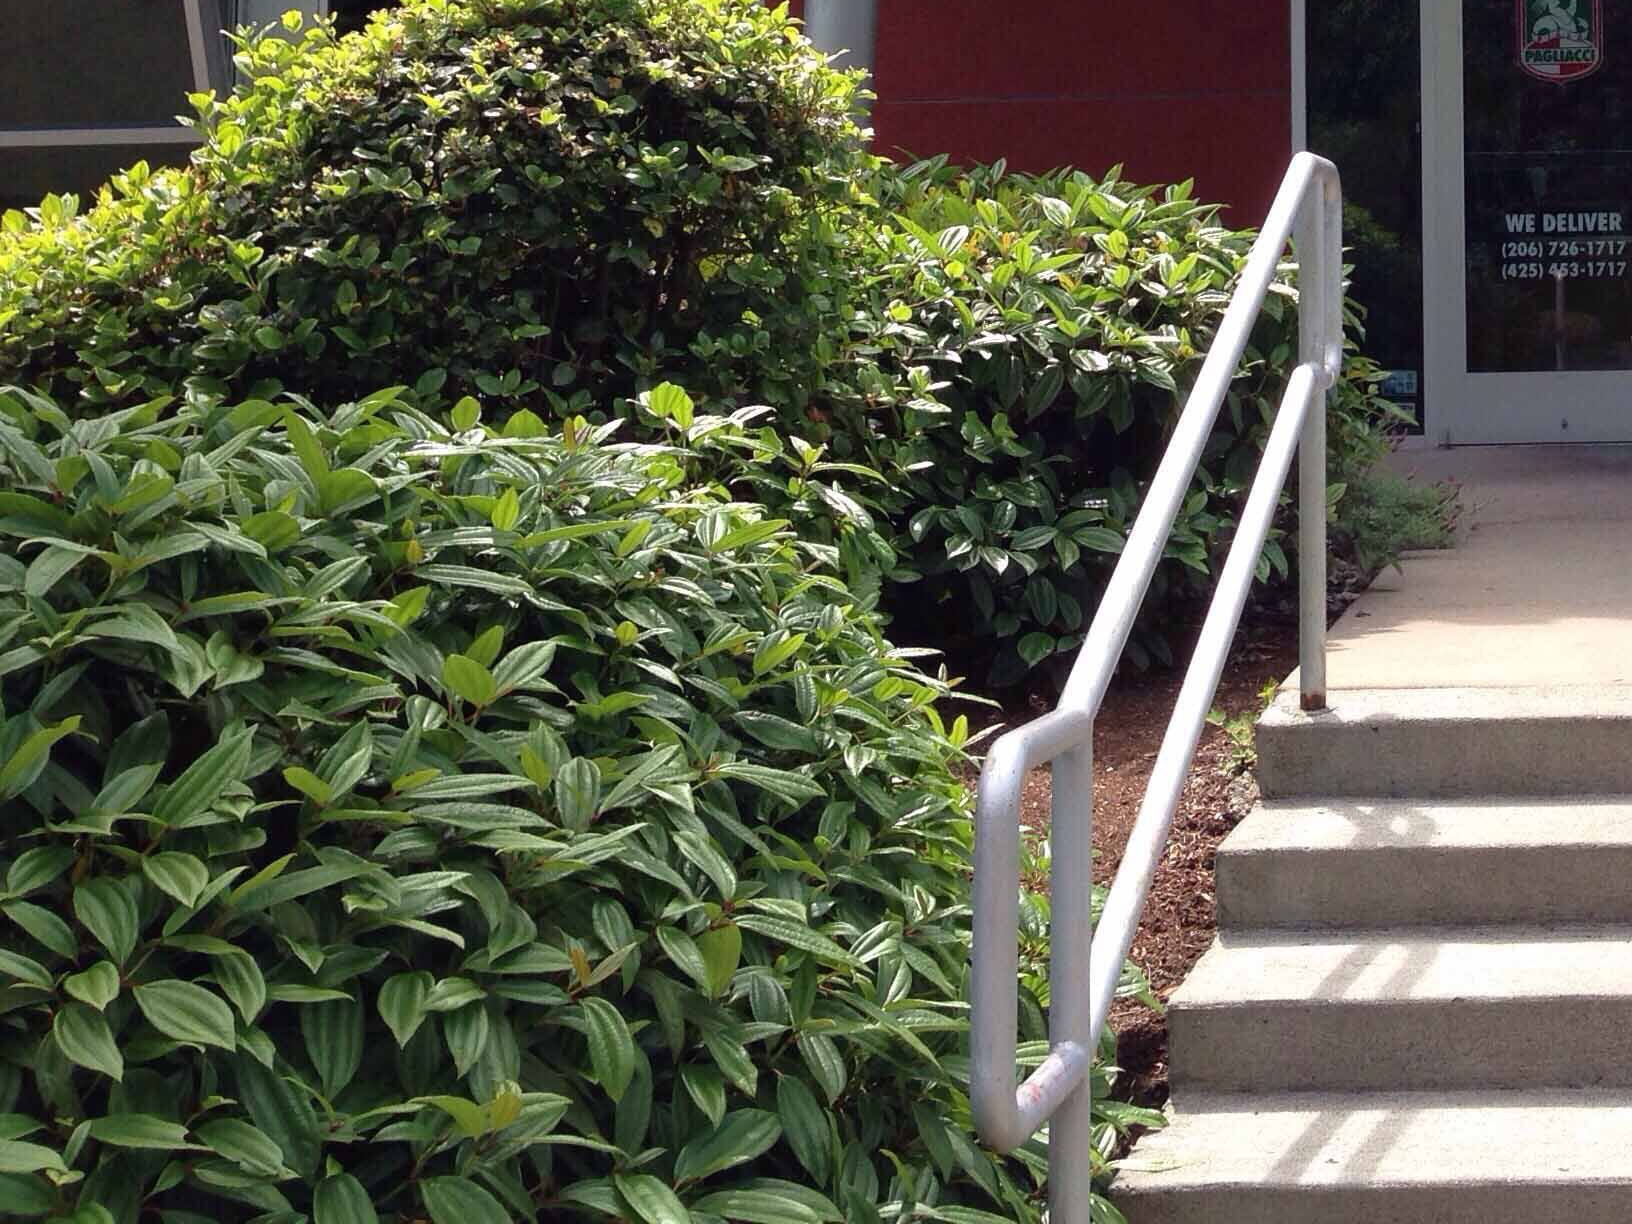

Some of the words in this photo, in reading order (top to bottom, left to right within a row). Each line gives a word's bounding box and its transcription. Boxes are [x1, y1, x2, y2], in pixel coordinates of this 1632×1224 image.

[1524, 48, 1595, 63] PAGLIACCI
[1505, 214, 1535, 232] WE
[1543, 212, 1622, 232] DELIVER
[1502, 241, 1543, 258] (206)
[1549, 240, 1626, 256] 726-1717
[1502, 263, 1543, 280] (425)
[1548, 261, 1626, 277] 453-1717
